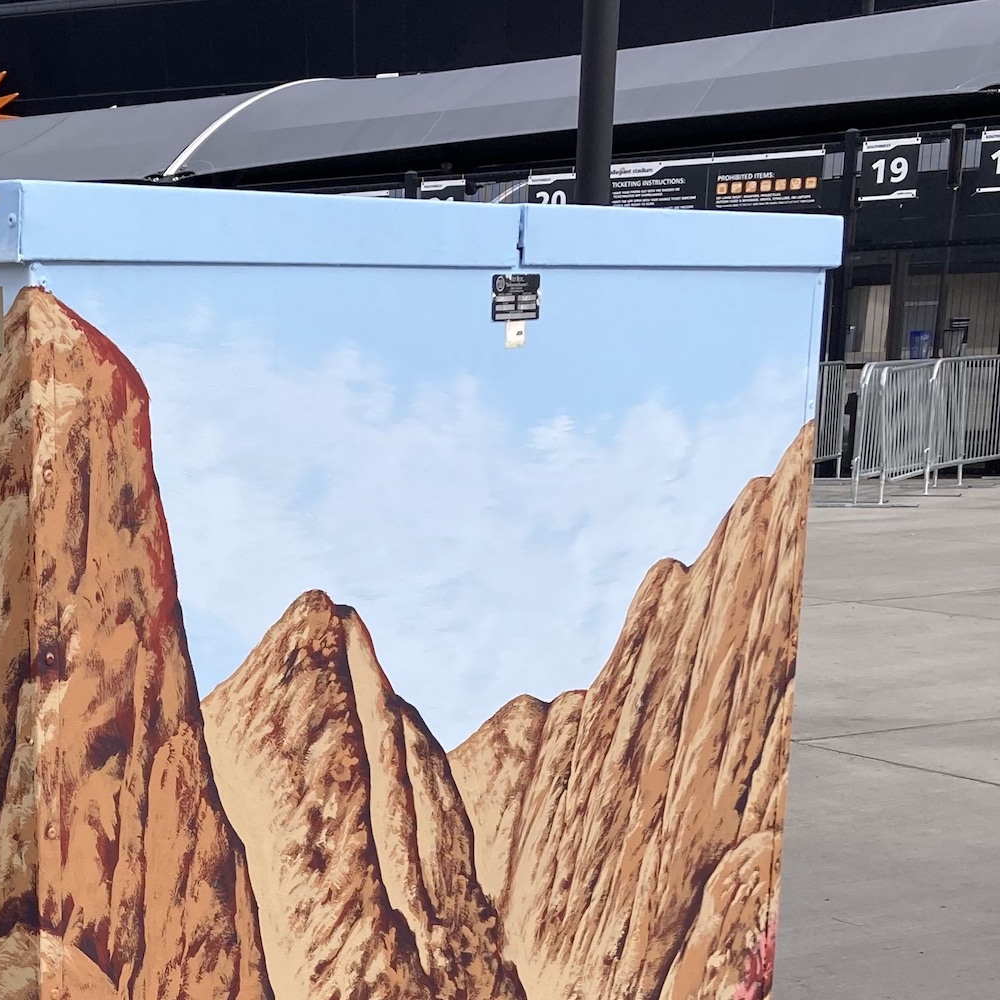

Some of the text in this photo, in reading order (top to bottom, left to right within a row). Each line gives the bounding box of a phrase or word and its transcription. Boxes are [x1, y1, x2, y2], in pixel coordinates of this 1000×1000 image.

[717, 172, 775, 181] PROHIBITED ITEMS:
[871, 157, 909, 184] 19
[612, 177, 686, 188] TICKETING INSTRUCTIONS:
[536, 190, 567, 205] 20
